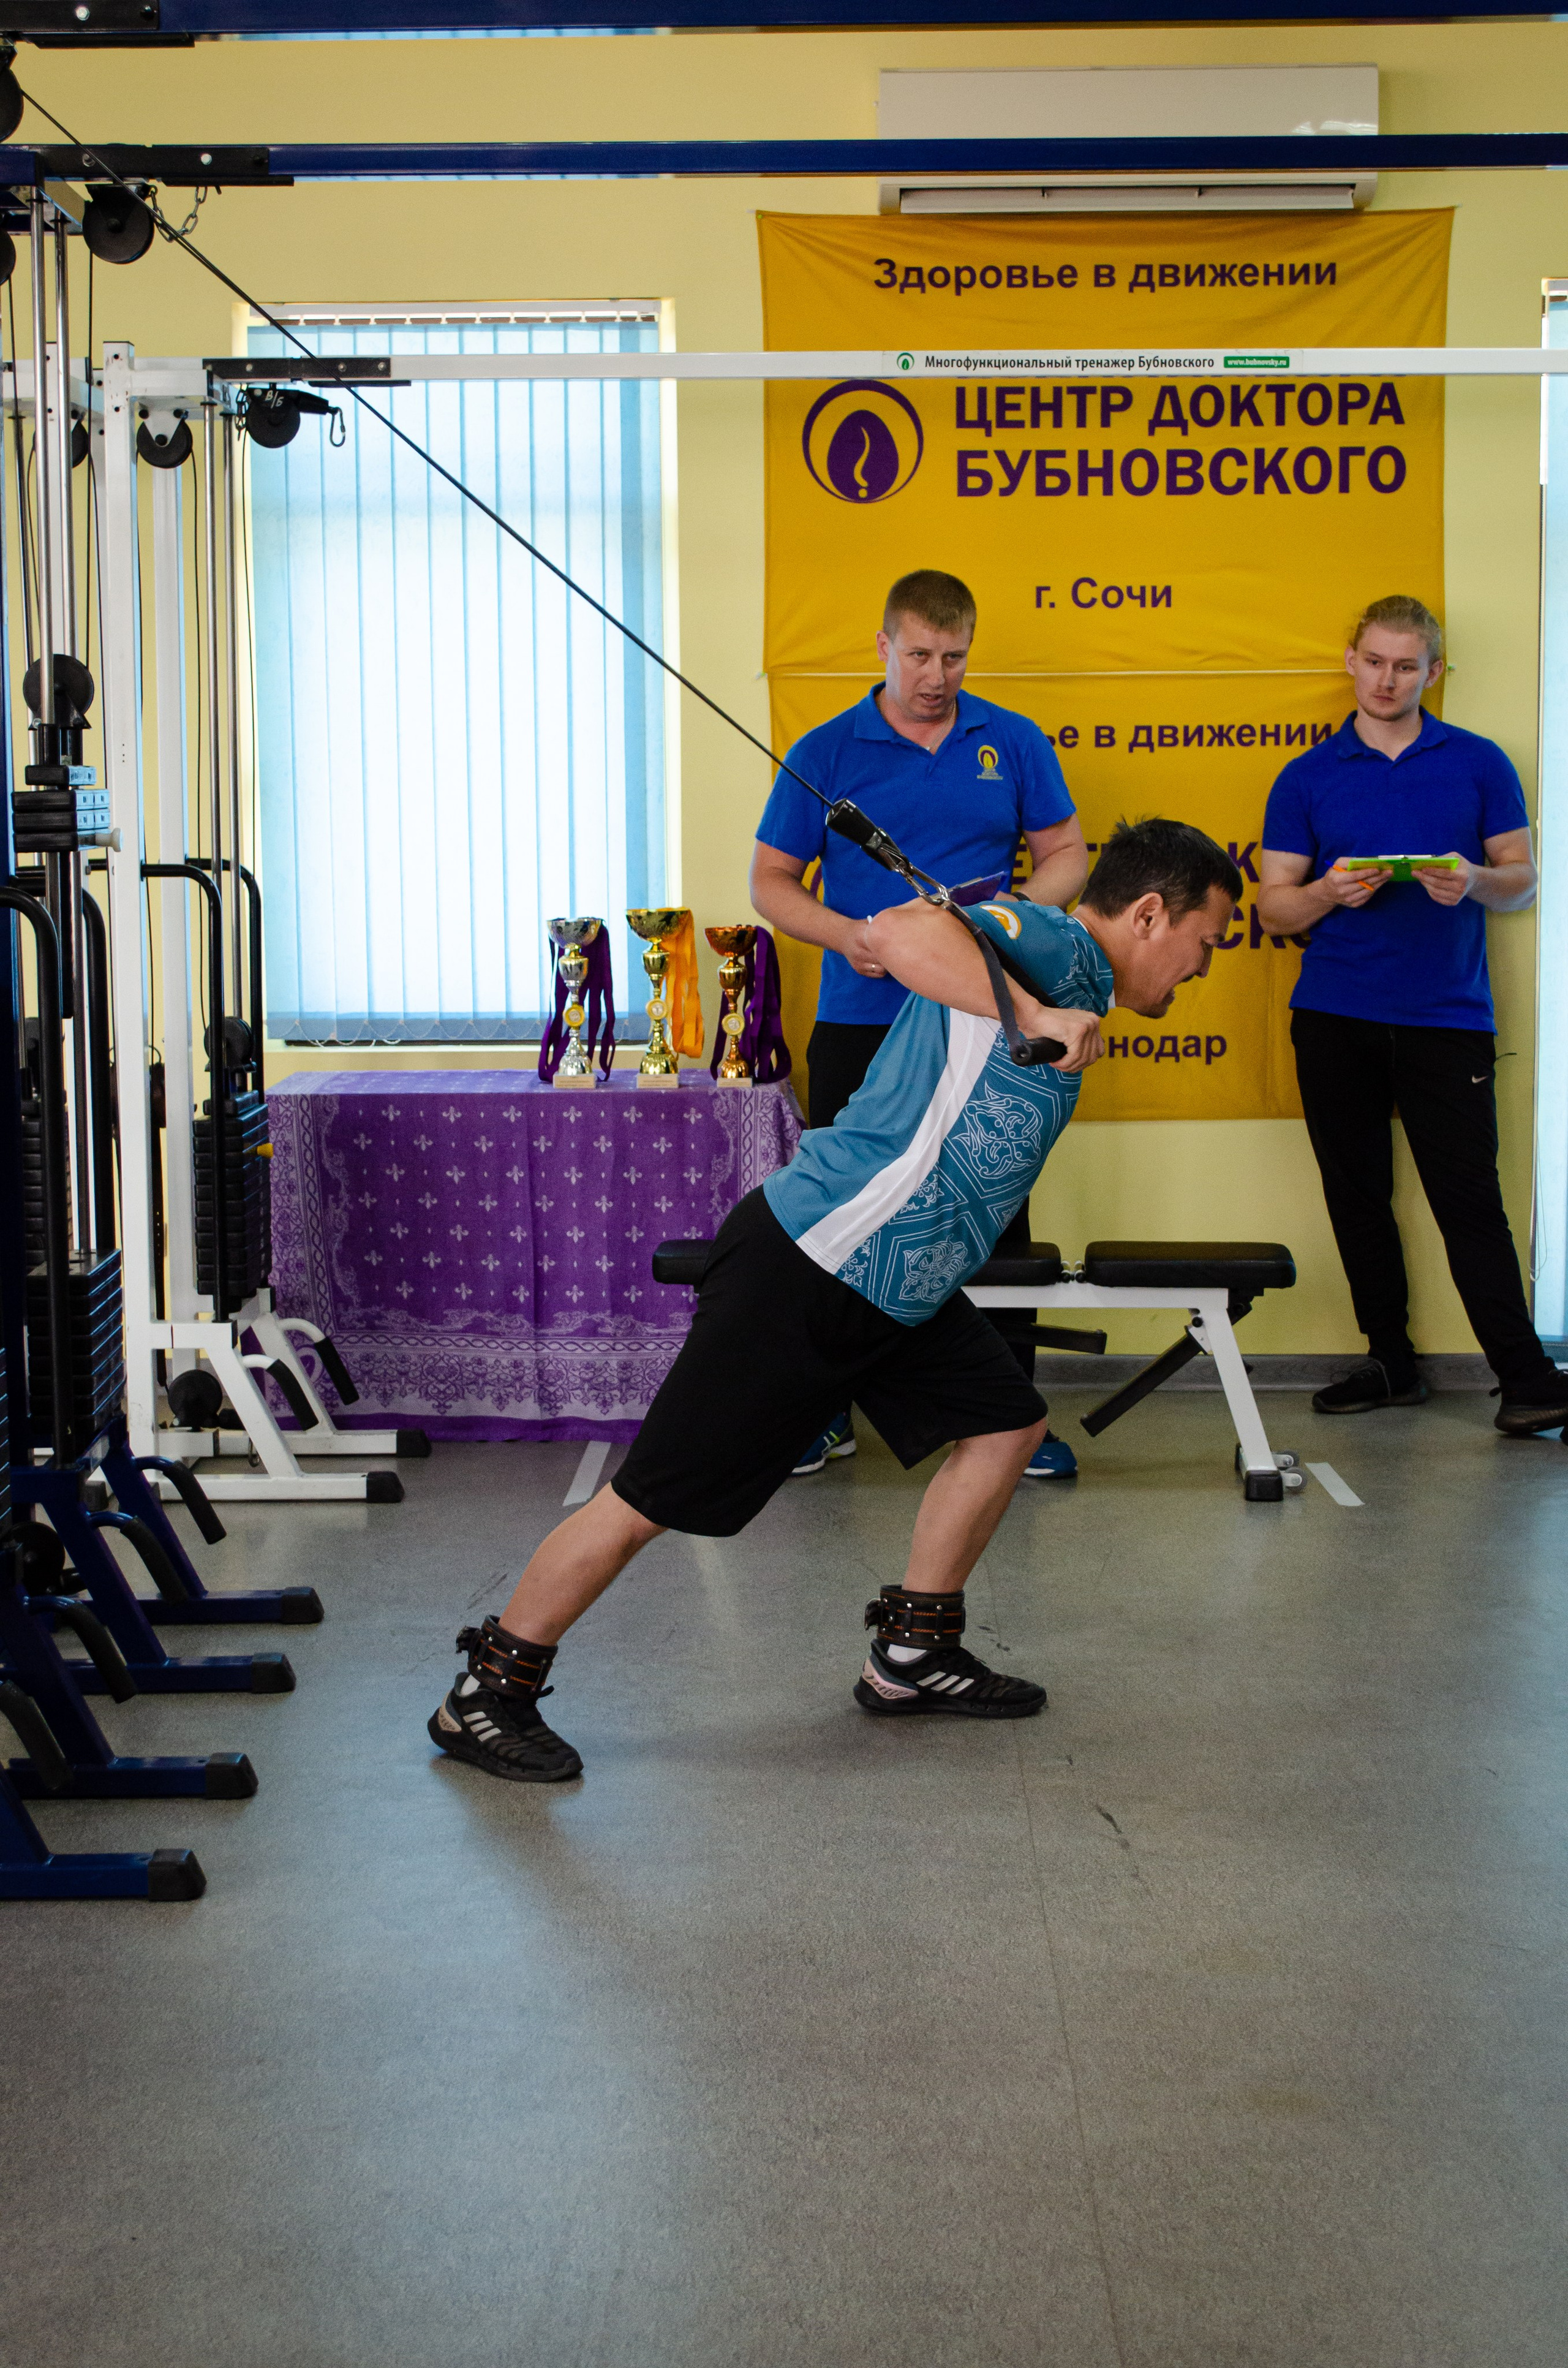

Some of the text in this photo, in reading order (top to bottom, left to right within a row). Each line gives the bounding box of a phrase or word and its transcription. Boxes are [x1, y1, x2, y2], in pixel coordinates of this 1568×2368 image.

[874, 257, 1337, 296] Здоровье в движении
[925, 354, 1215, 371] Многофункциональный тренажер Бубновского
[1227, 358, 1287, 367] www.bubnovsky.ru
[956, 382, 1406, 437] ЦЕНТР ДОКТОРА
[957, 445, 1407, 497] БУБНОВСКОГО
[1035, 577, 1172, 609] г. Сочи
[1094, 725, 1116, 748] в
[1128, 723, 1332, 754] движении
[1101, 1035, 1227, 1065] нодар
